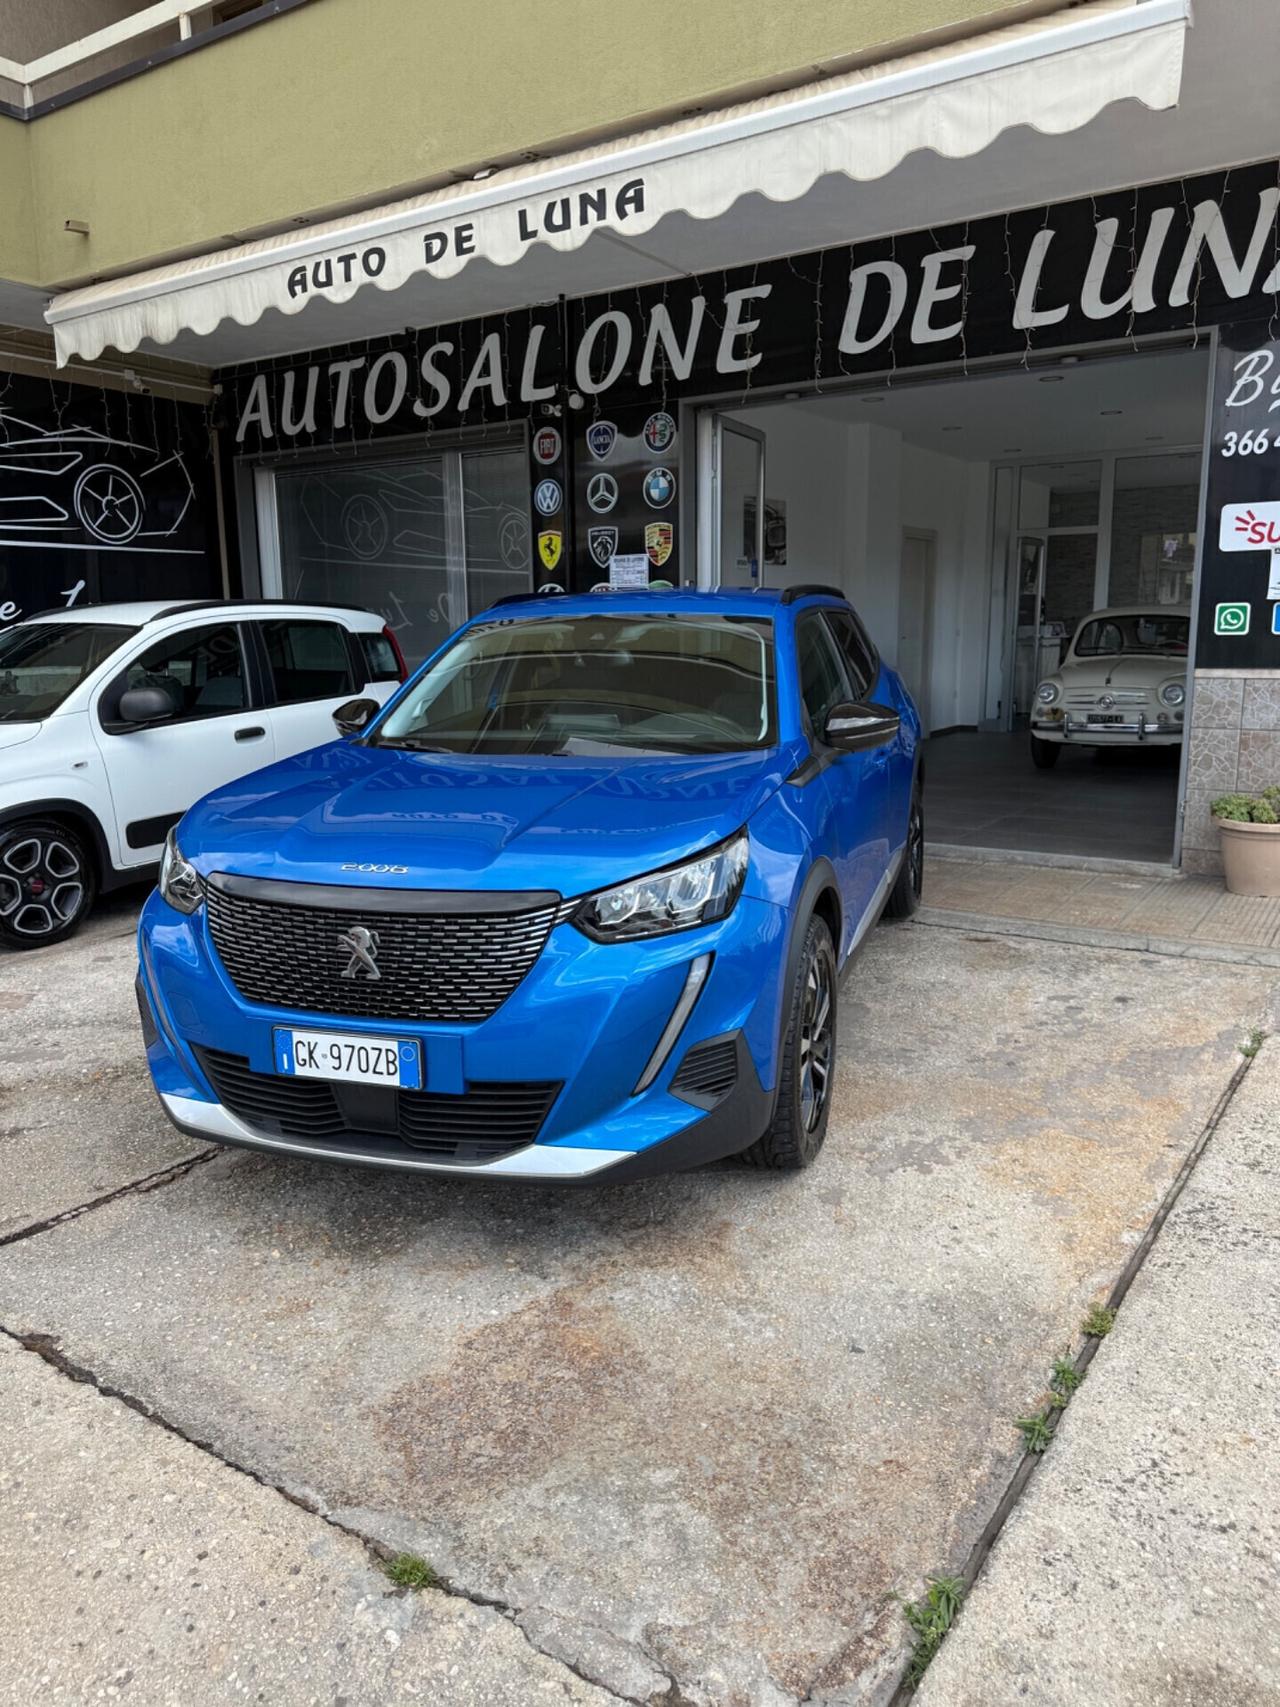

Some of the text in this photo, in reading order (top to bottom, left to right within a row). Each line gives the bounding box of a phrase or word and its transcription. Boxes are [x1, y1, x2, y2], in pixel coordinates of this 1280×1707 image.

[287, 178, 647, 299] AUTO DE LUNA
[235, 187, 1280, 443] AUTOSALONE DE LUN
[1221, 428, 1269, 457] 366
[294, 1040, 320, 1069] GK
[329, 1043, 399, 1076] 970ZB
